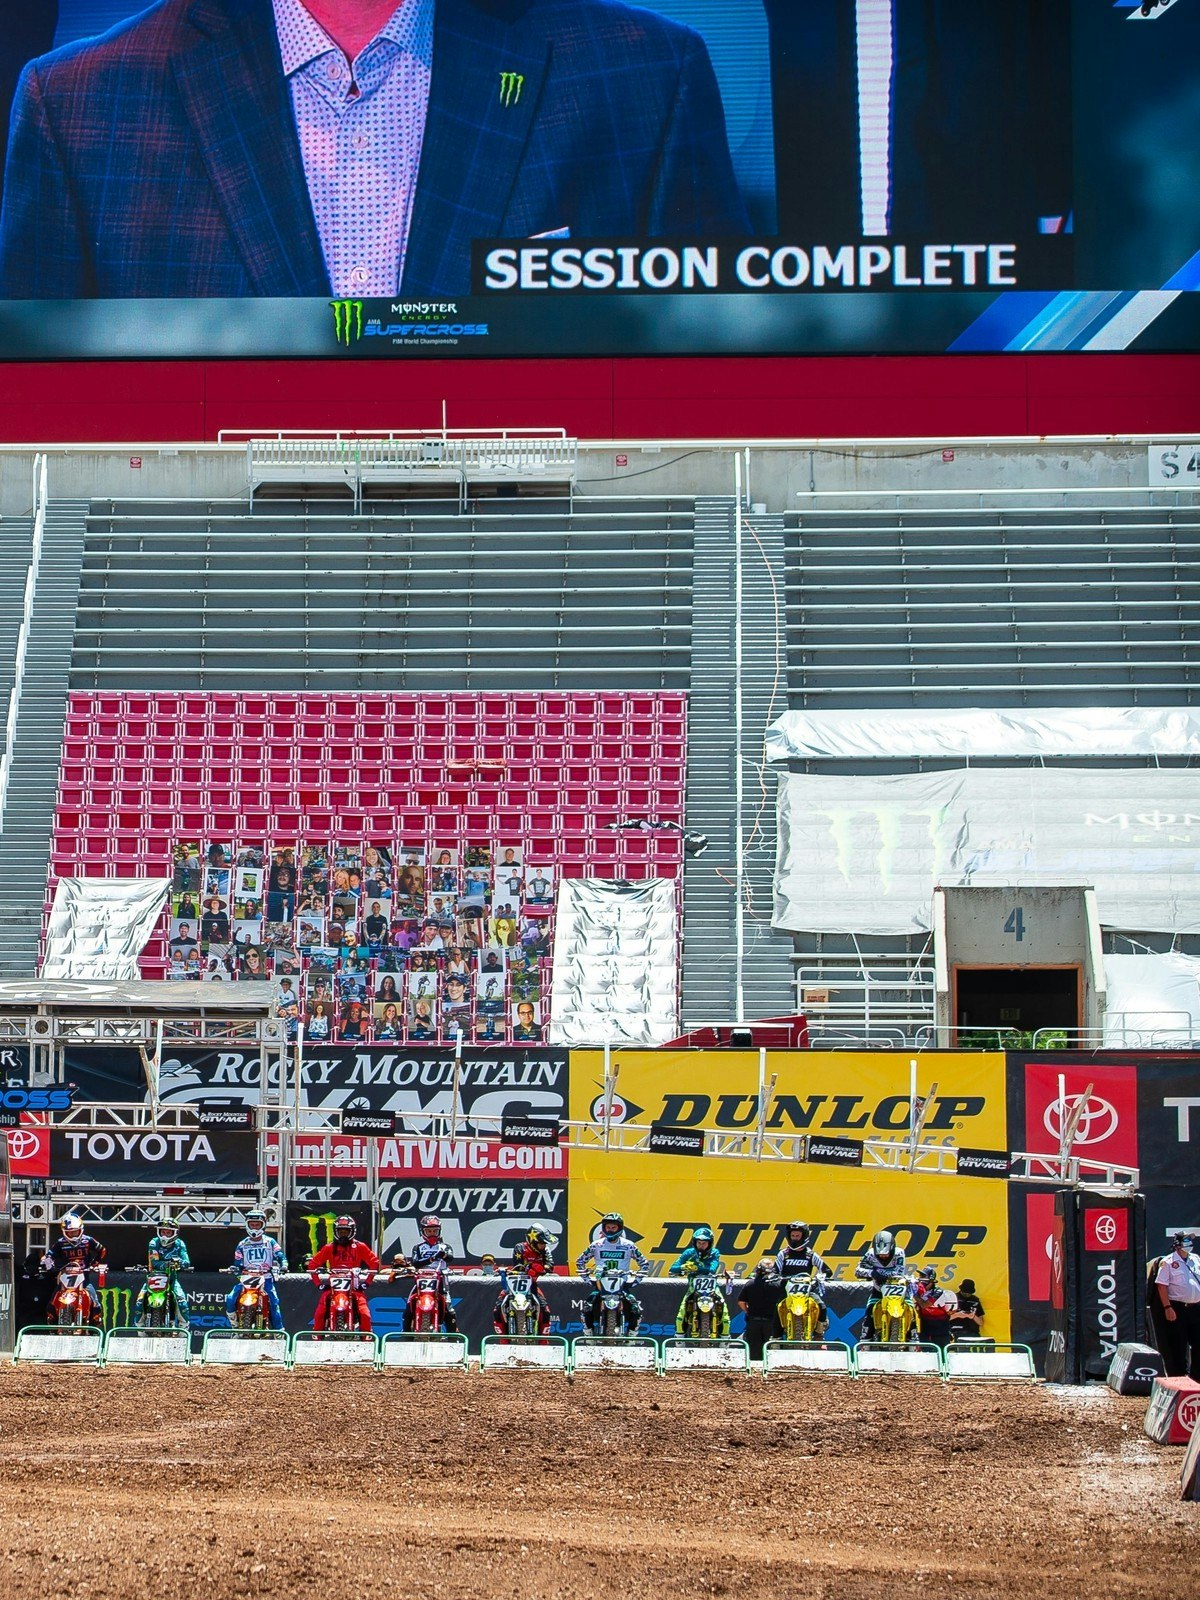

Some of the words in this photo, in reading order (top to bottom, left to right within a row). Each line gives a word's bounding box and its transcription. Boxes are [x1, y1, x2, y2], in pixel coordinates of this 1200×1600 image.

[485, 245, 720, 289] SESSION
[736, 244, 1017, 288] COMPLETE
[391, 302, 457, 314] MONSTER
[364, 324, 489, 336] SUPERCROSS
[1003, 906, 1026, 941] 4
[209, 1053, 342, 1085] ROCKY
[349, 1054, 566, 1087] MOUNTAIN
[652, 1094, 986, 1129] DUNLOP
[65, 1132, 216, 1162] TOYOTA
[266, 1138, 563, 1171] ountainATVMC.com
[350, 1181, 565, 1213] MOUNTAIN
[650, 1222, 987, 1258] DUNLOP
[249, 1249, 266, 1260] FLY
[66, 1275, 78, 1287] 1
[148, 1276, 167, 1288] 3
[242, 1277, 261, 1288] 4
[332, 1279, 352, 1290] 27
[418, 1280, 437, 1290] 64
[511, 1279, 528, 1292] 16
[607, 1278, 619, 1290] 7
[694, 1278, 715, 1290] 824
[1097, 1259, 1118, 1358] TOYOTA
